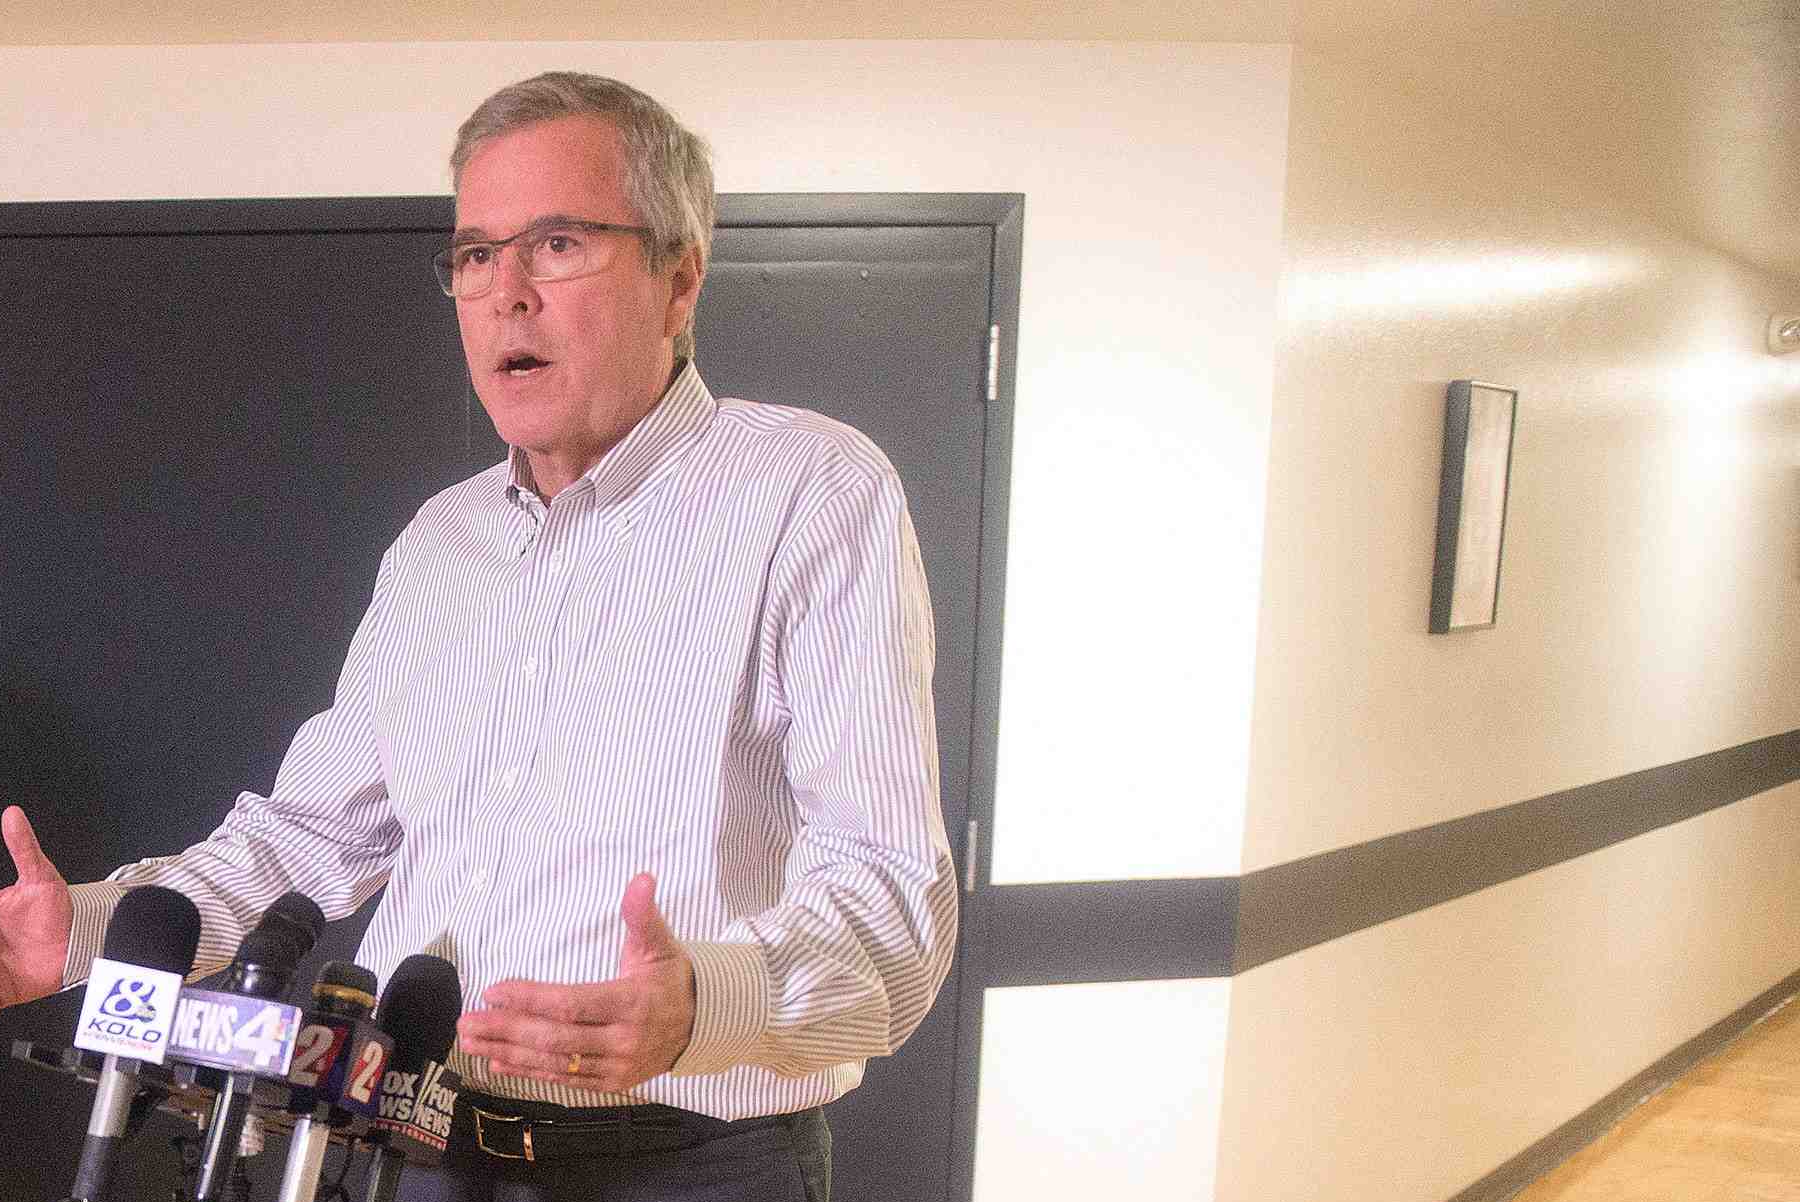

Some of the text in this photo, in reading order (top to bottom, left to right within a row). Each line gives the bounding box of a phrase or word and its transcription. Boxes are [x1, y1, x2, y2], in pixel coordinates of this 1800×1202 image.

[88, 1017, 162, 1043] KOLO
[169, 998, 282, 1067] NEWS 4
[288, 1024, 335, 1087] 2
[350, 1040, 383, 1104] 2
[383, 1070, 419, 1098] OX
[428, 1082, 458, 1116] FOX
[414, 1103, 452, 1138] NEWS
